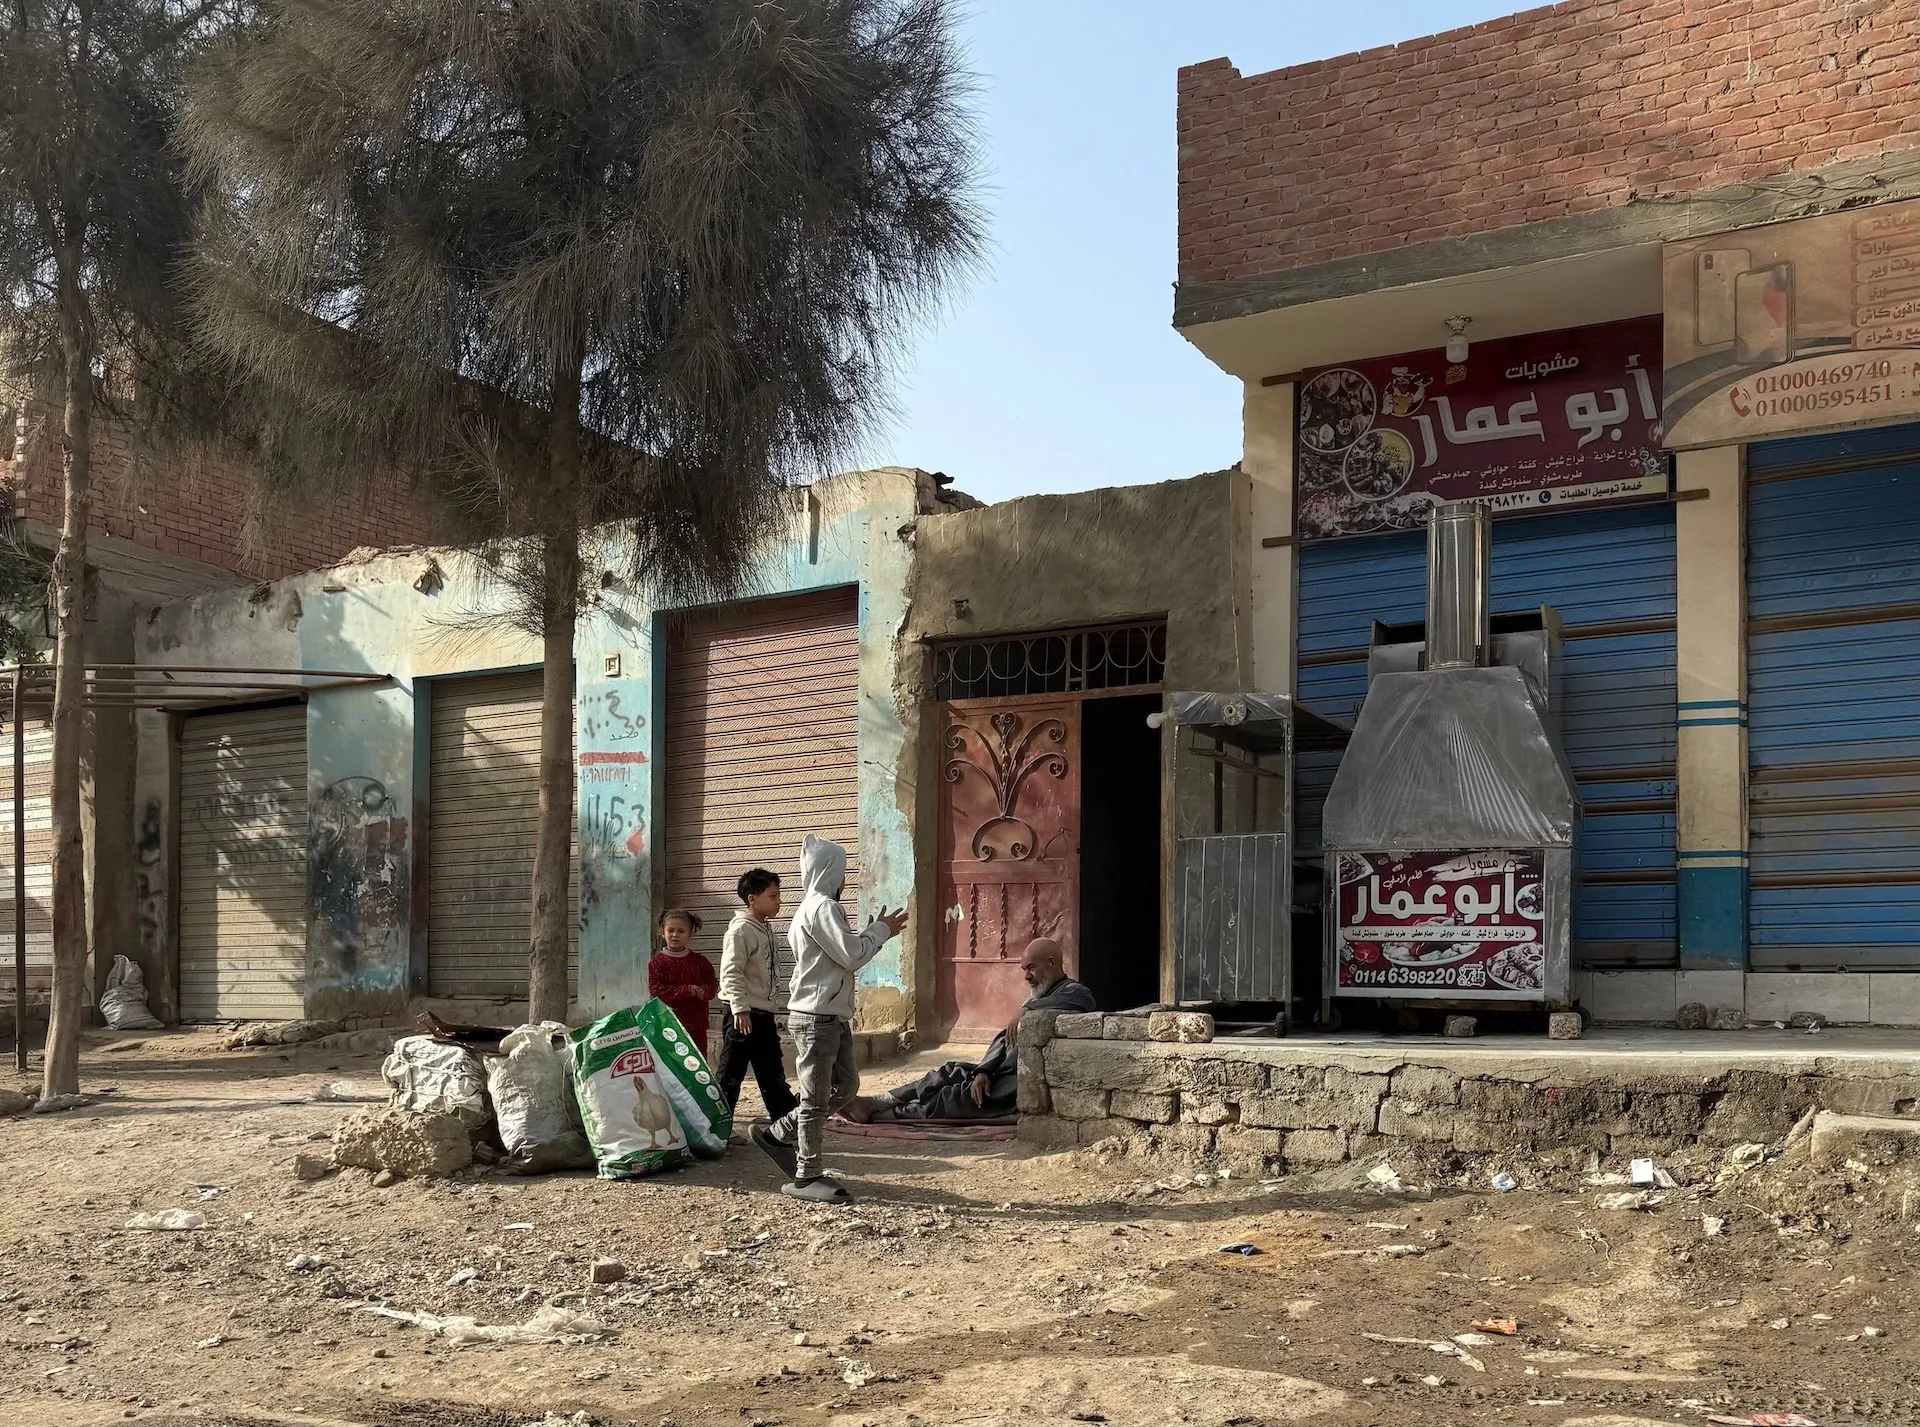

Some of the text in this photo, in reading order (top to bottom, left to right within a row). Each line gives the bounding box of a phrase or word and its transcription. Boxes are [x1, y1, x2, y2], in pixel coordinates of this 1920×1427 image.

[1860, 307, 1890, 325] كاش
[1865, 328, 1893, 345] شراء
[1505, 352, 1580, 380] مشويات
[1756, 360, 1892, 395] 01000469740
[1756, 383, 1893, 416] 01000595451
[1411, 354, 1658, 468] أبو عمار
[1544, 455, 1566, 469] شيش
[1566, 453, 1585, 467] فراخ
[1593, 449, 1617, 463] شواية
[1617, 447, 1638, 461] فراخ
[1479, 464, 1510, 477] حواوشي
[1518, 459, 1537, 470] كفتة
[1452, 469, 1471, 480] حمام
[1479, 470, 1583, 491] طرب مشوي سندوتش كبدة
[1559, 481, 1643, 500] خدمة توصيل الطلبات
[1452, 854, 1498, 876] مشويات
[1351, 859, 1517, 925] أبو عمار
